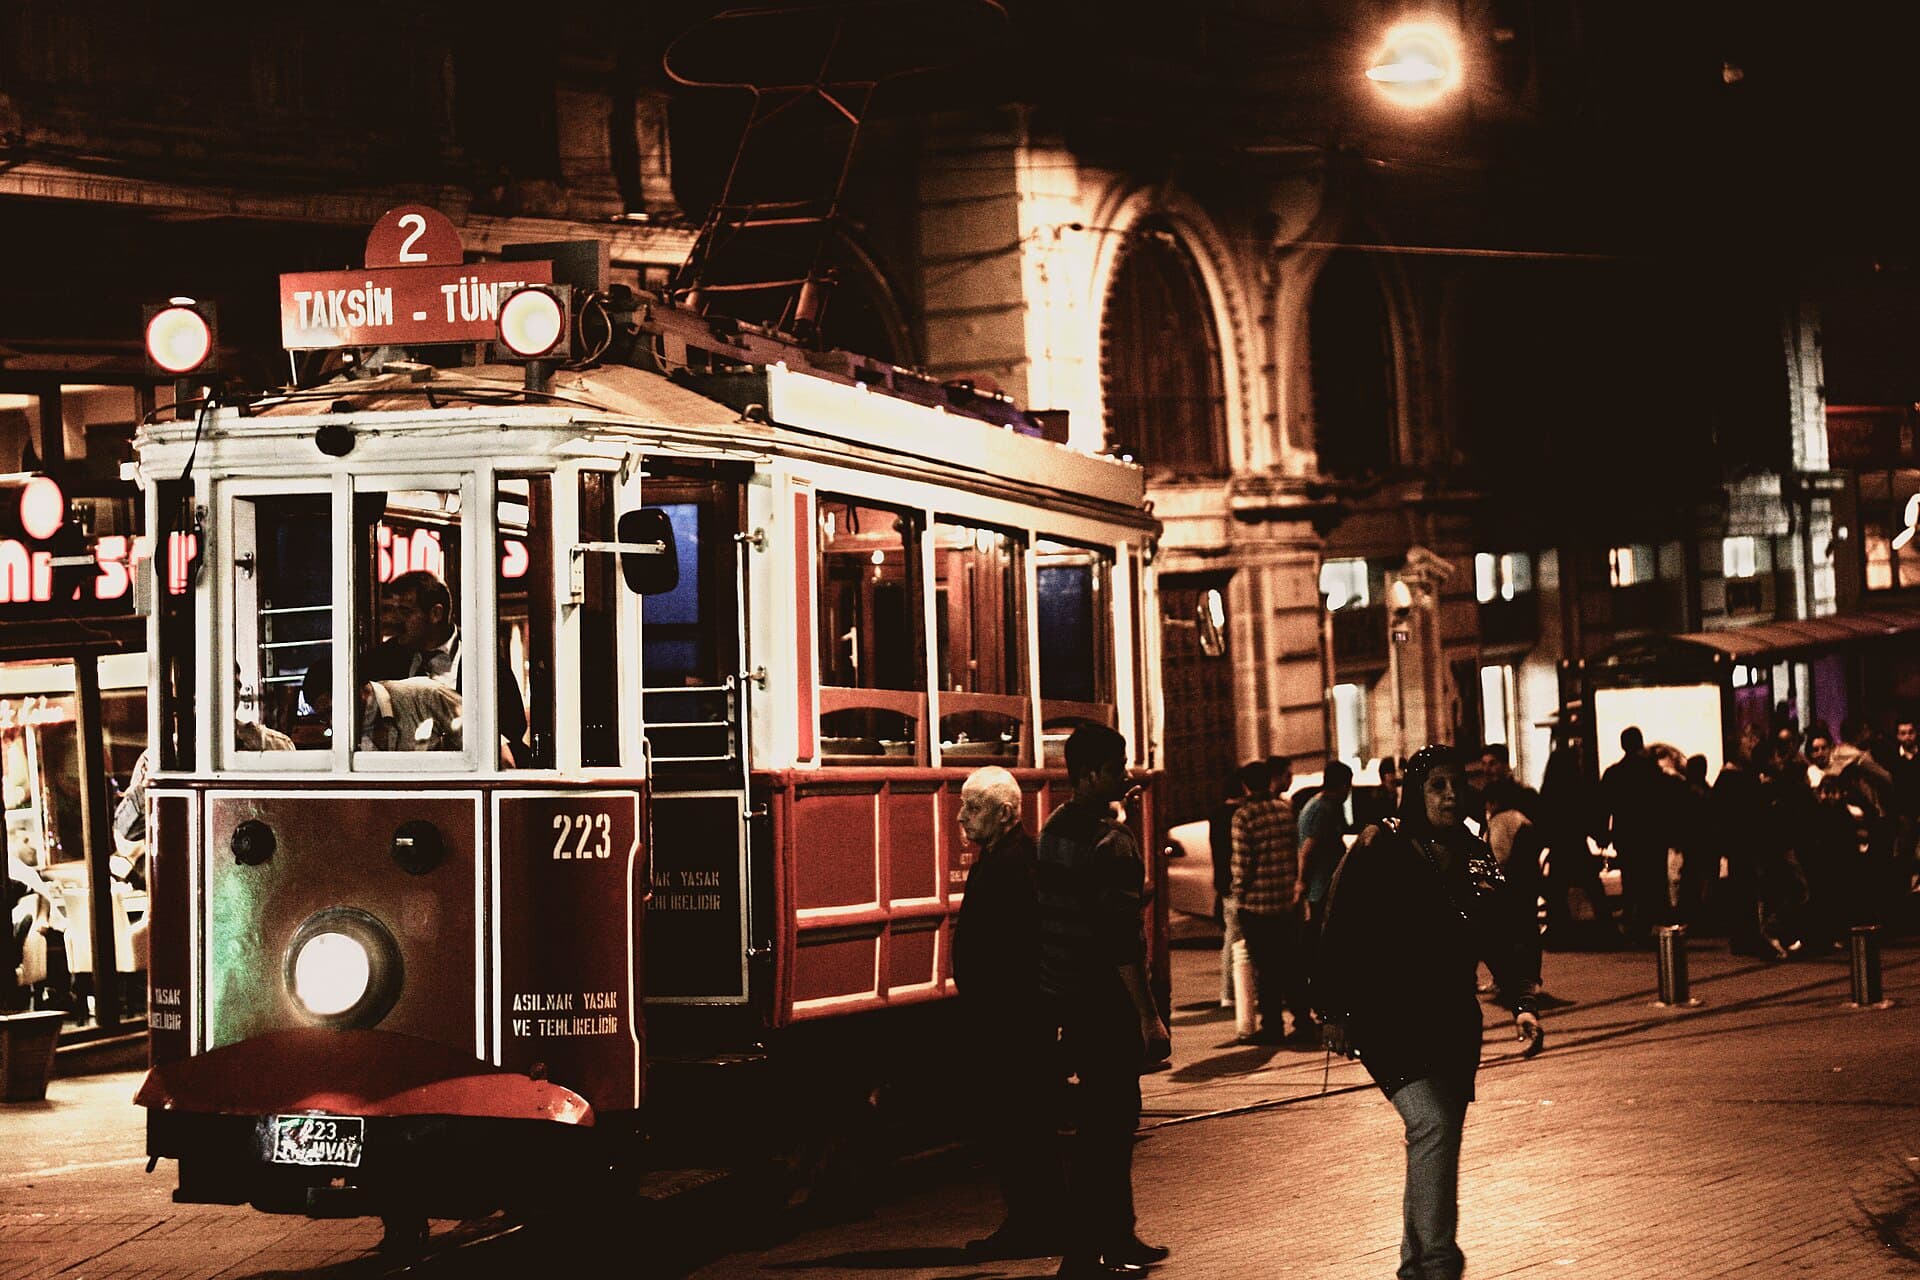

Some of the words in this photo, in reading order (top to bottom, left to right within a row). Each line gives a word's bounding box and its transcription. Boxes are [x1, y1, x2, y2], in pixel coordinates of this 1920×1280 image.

[398, 213, 428, 263] 2
[294, 280, 393, 330] TAKSİM
[441, 276, 530, 323] TÜN
[553, 813, 611, 860] 223
[680, 871, 720, 887] YASAK
[512, 992, 573, 1011] ASILMAK
[583, 991, 617, 1010] YASAK
[512, 1019, 532, 1037] VE
